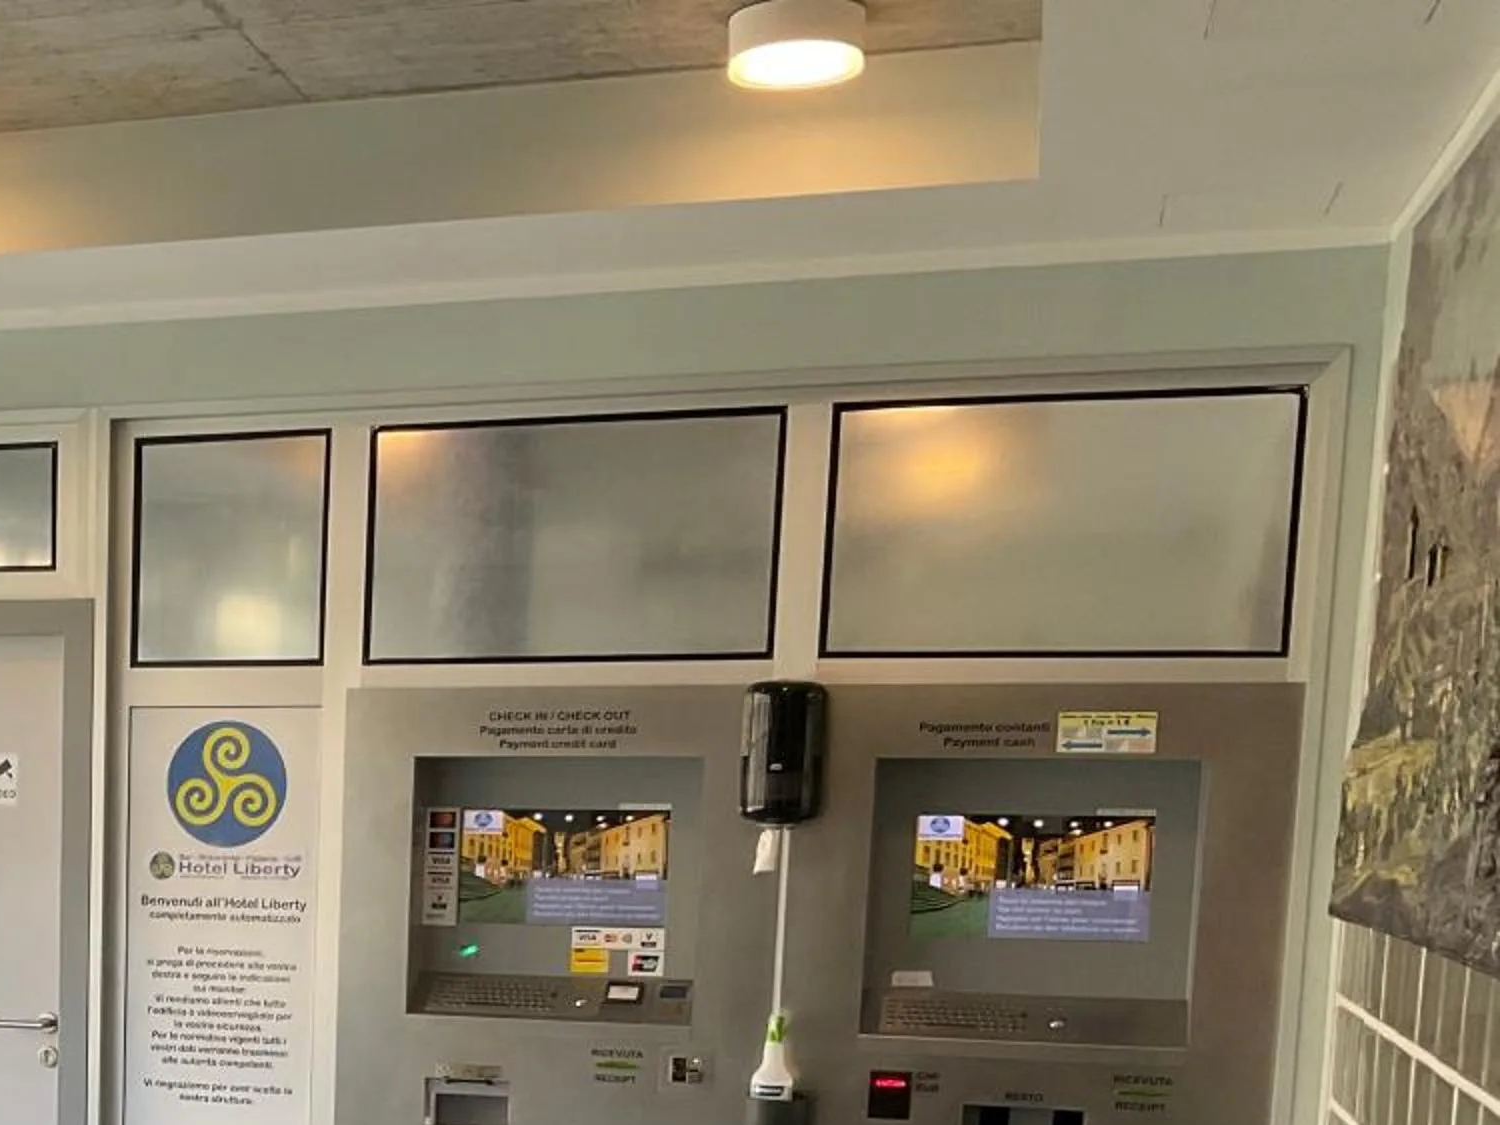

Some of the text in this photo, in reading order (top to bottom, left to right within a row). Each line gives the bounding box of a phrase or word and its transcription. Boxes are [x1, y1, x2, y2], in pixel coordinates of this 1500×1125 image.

[489, 711, 532, 721] CHECK
[557, 711, 600, 721] CHECK
[603, 711, 630, 721] OUT
[479, 725, 636, 737] Pagamento carta di credito
[919, 721, 1051, 734] Pagamento contanti
[500, 739, 548, 750] Payment
[589, 739, 617, 749] card
[944, 738, 1035, 748] Payment cash
[179, 861, 301, 878] Hotel Liberty
[141, 893, 203, 907] Benvenuti
[261, 897, 307, 912] Liberty
[1113, 1075, 1173, 1087] RICEVUTA
[1005, 1092, 1043, 1102] RESTO
[1114, 1102, 1166, 1113] RECEIPT
